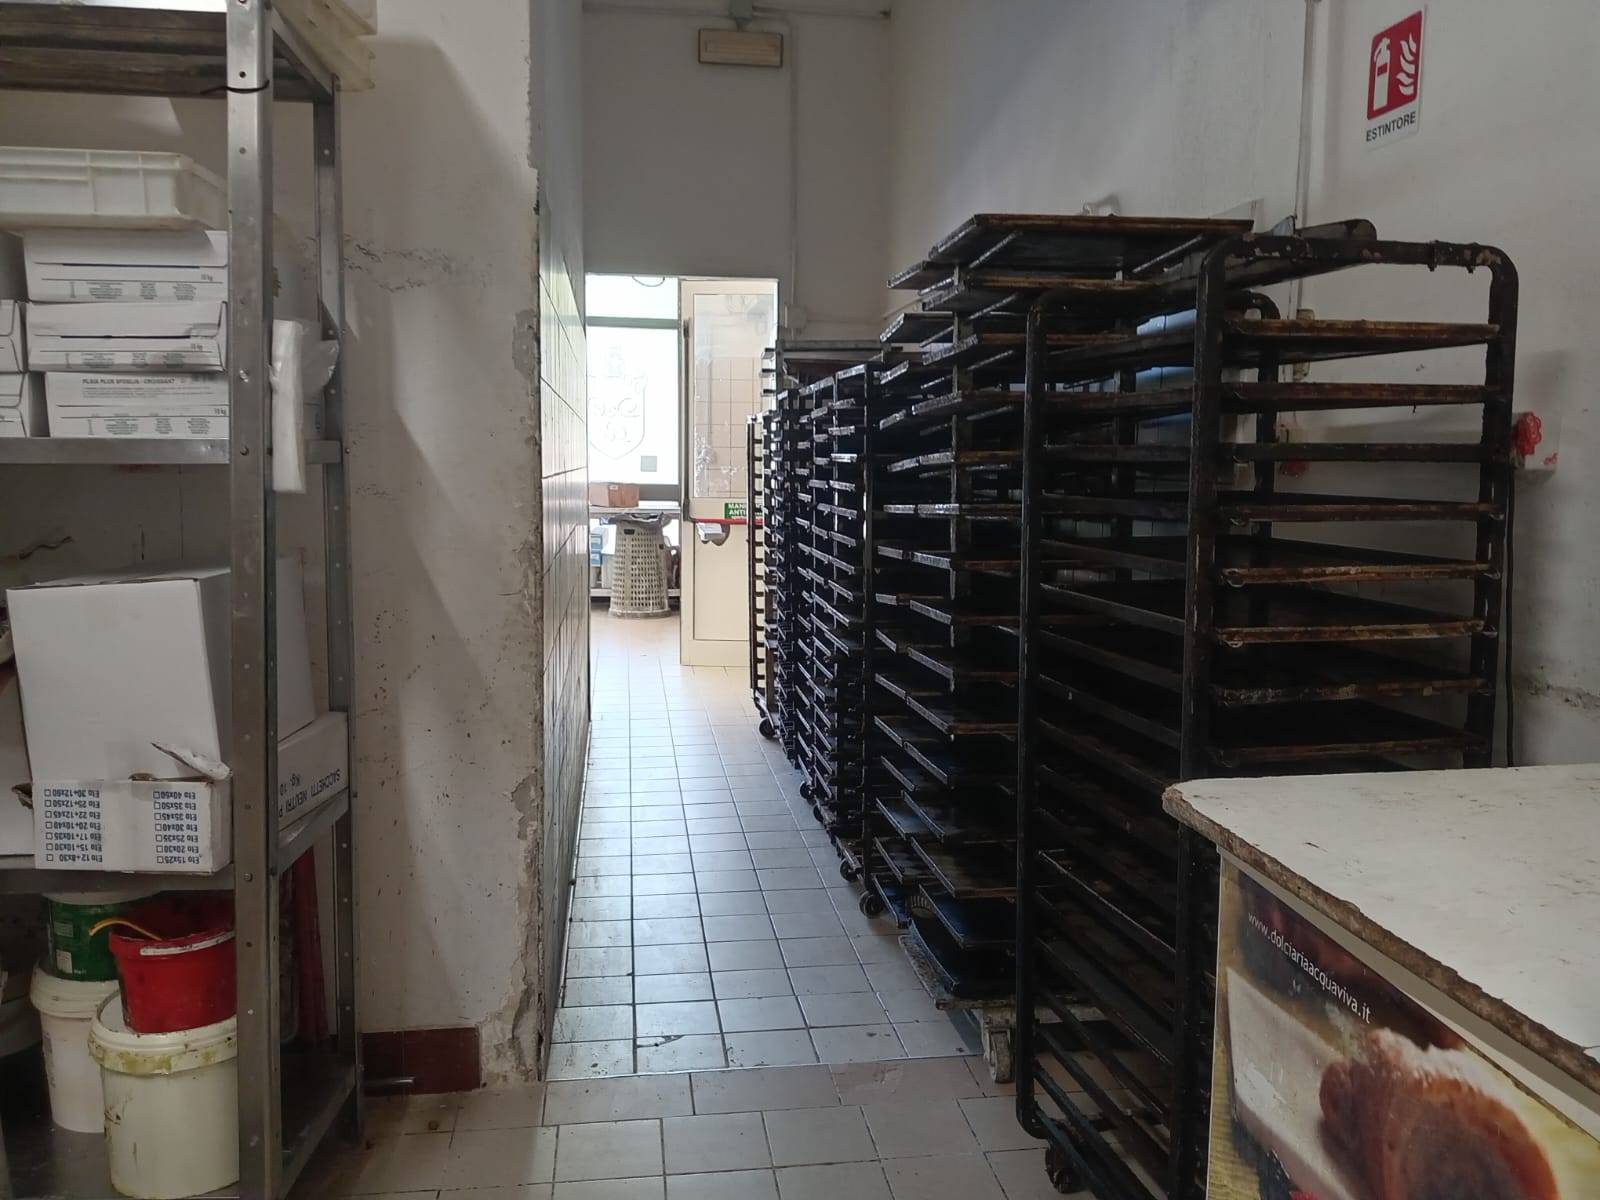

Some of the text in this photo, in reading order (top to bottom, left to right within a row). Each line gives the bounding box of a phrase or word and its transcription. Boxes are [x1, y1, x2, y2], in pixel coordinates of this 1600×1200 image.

[1365, 110, 1417, 142] ESTINTORE
[310, 768, 340, 797] SACCHETTI
[285, 790, 308, 812] NEUTRI
[1248, 911, 1371, 1024] www.dolciariaacquaviva.it
